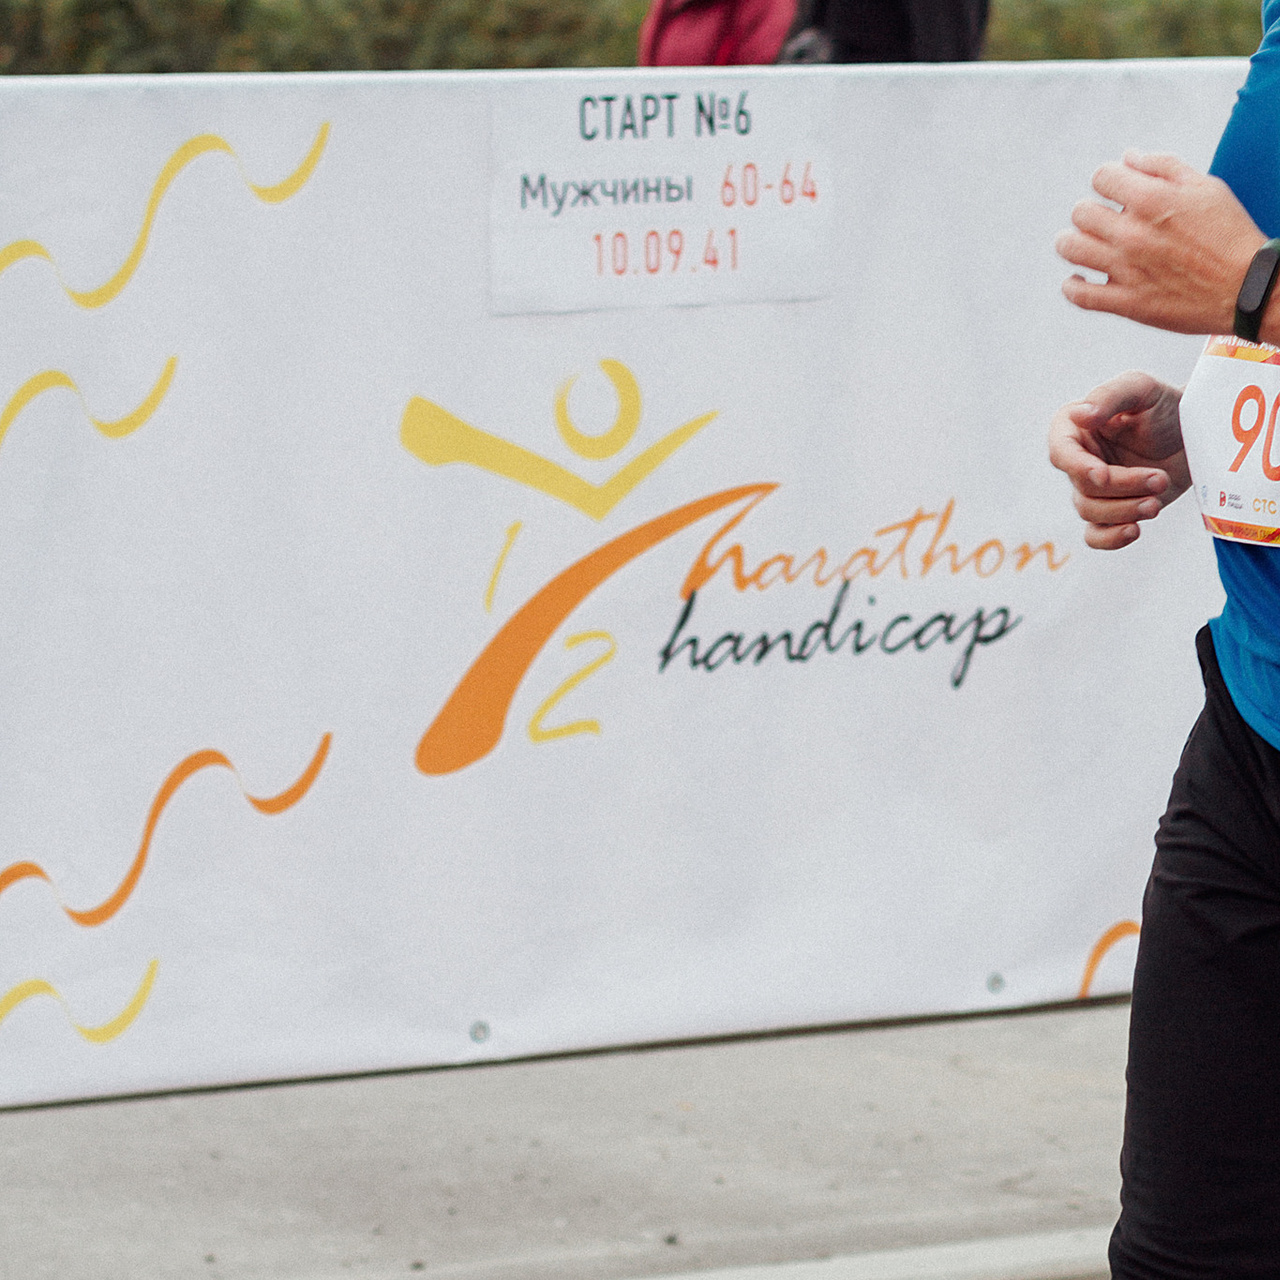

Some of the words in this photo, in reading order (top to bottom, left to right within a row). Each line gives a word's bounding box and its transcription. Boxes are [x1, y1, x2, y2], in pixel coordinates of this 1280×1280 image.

[578, 92, 680, 141] СТАРТ
[694, 90, 753, 137] №6
[520, 173, 694, 217] Мужчины
[721, 161, 818, 208] 60-64
[593, 228, 740, 276] 10.09.41
[681, 495, 1070, 602] marathon
[658, 580, 1023, 690] handicap
